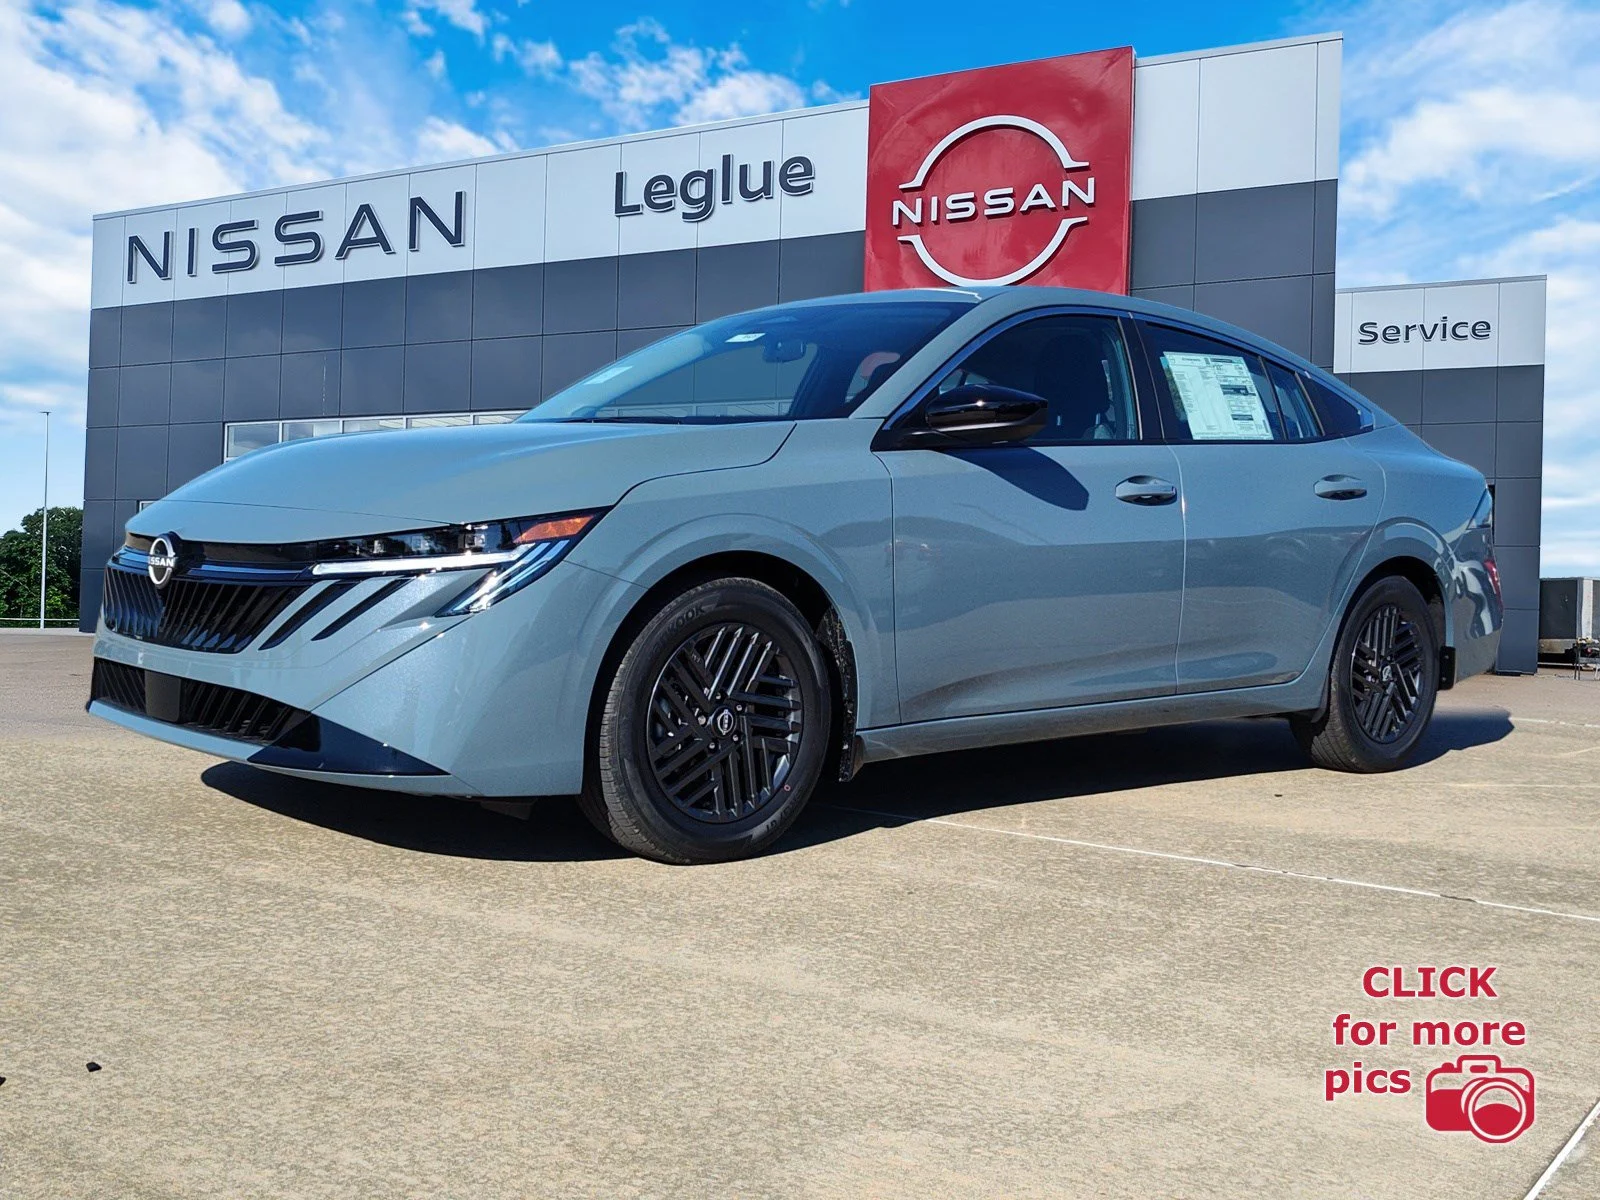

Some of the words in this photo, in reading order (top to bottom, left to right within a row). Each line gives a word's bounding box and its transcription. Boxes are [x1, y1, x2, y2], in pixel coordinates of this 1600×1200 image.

[614, 153, 815, 222] Leglue
[892, 177, 1096, 227] NISSAN
[127, 191, 466, 284] NISSAN
[1358, 315, 1491, 345] Service
